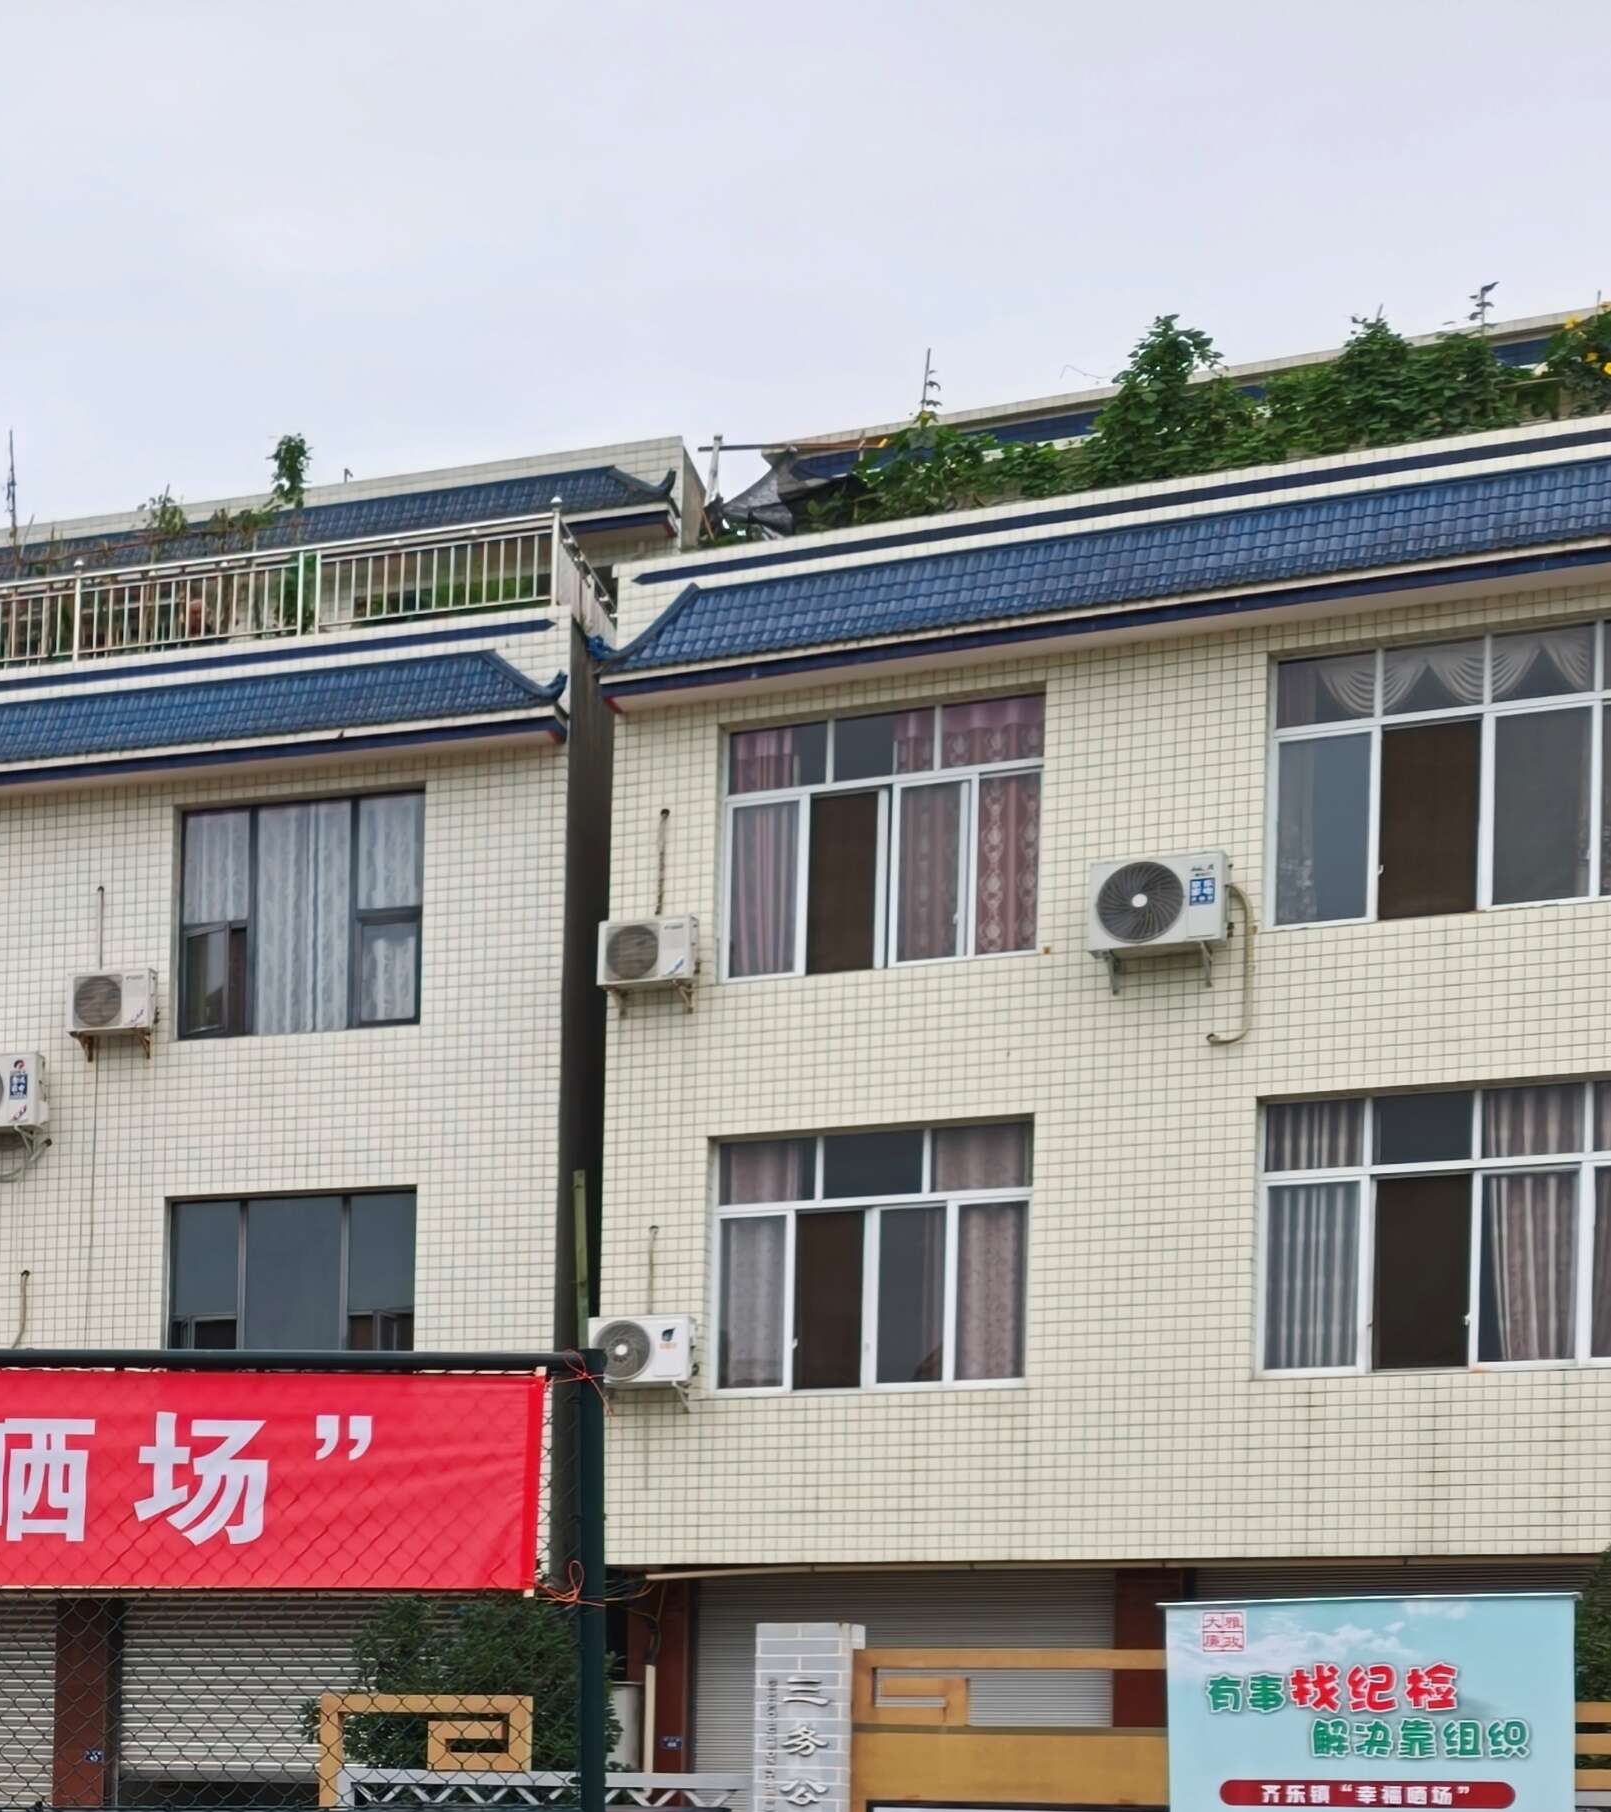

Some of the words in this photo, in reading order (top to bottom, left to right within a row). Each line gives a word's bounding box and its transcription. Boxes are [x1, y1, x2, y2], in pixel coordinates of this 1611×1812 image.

[1206, 1662, 1459, 1713] 有事找纪检
[1310, 1719, 1532, 1759] 解决靠组织
[1262, 1783, 1471, 1807] 齐乐镇“幸福晒场”
